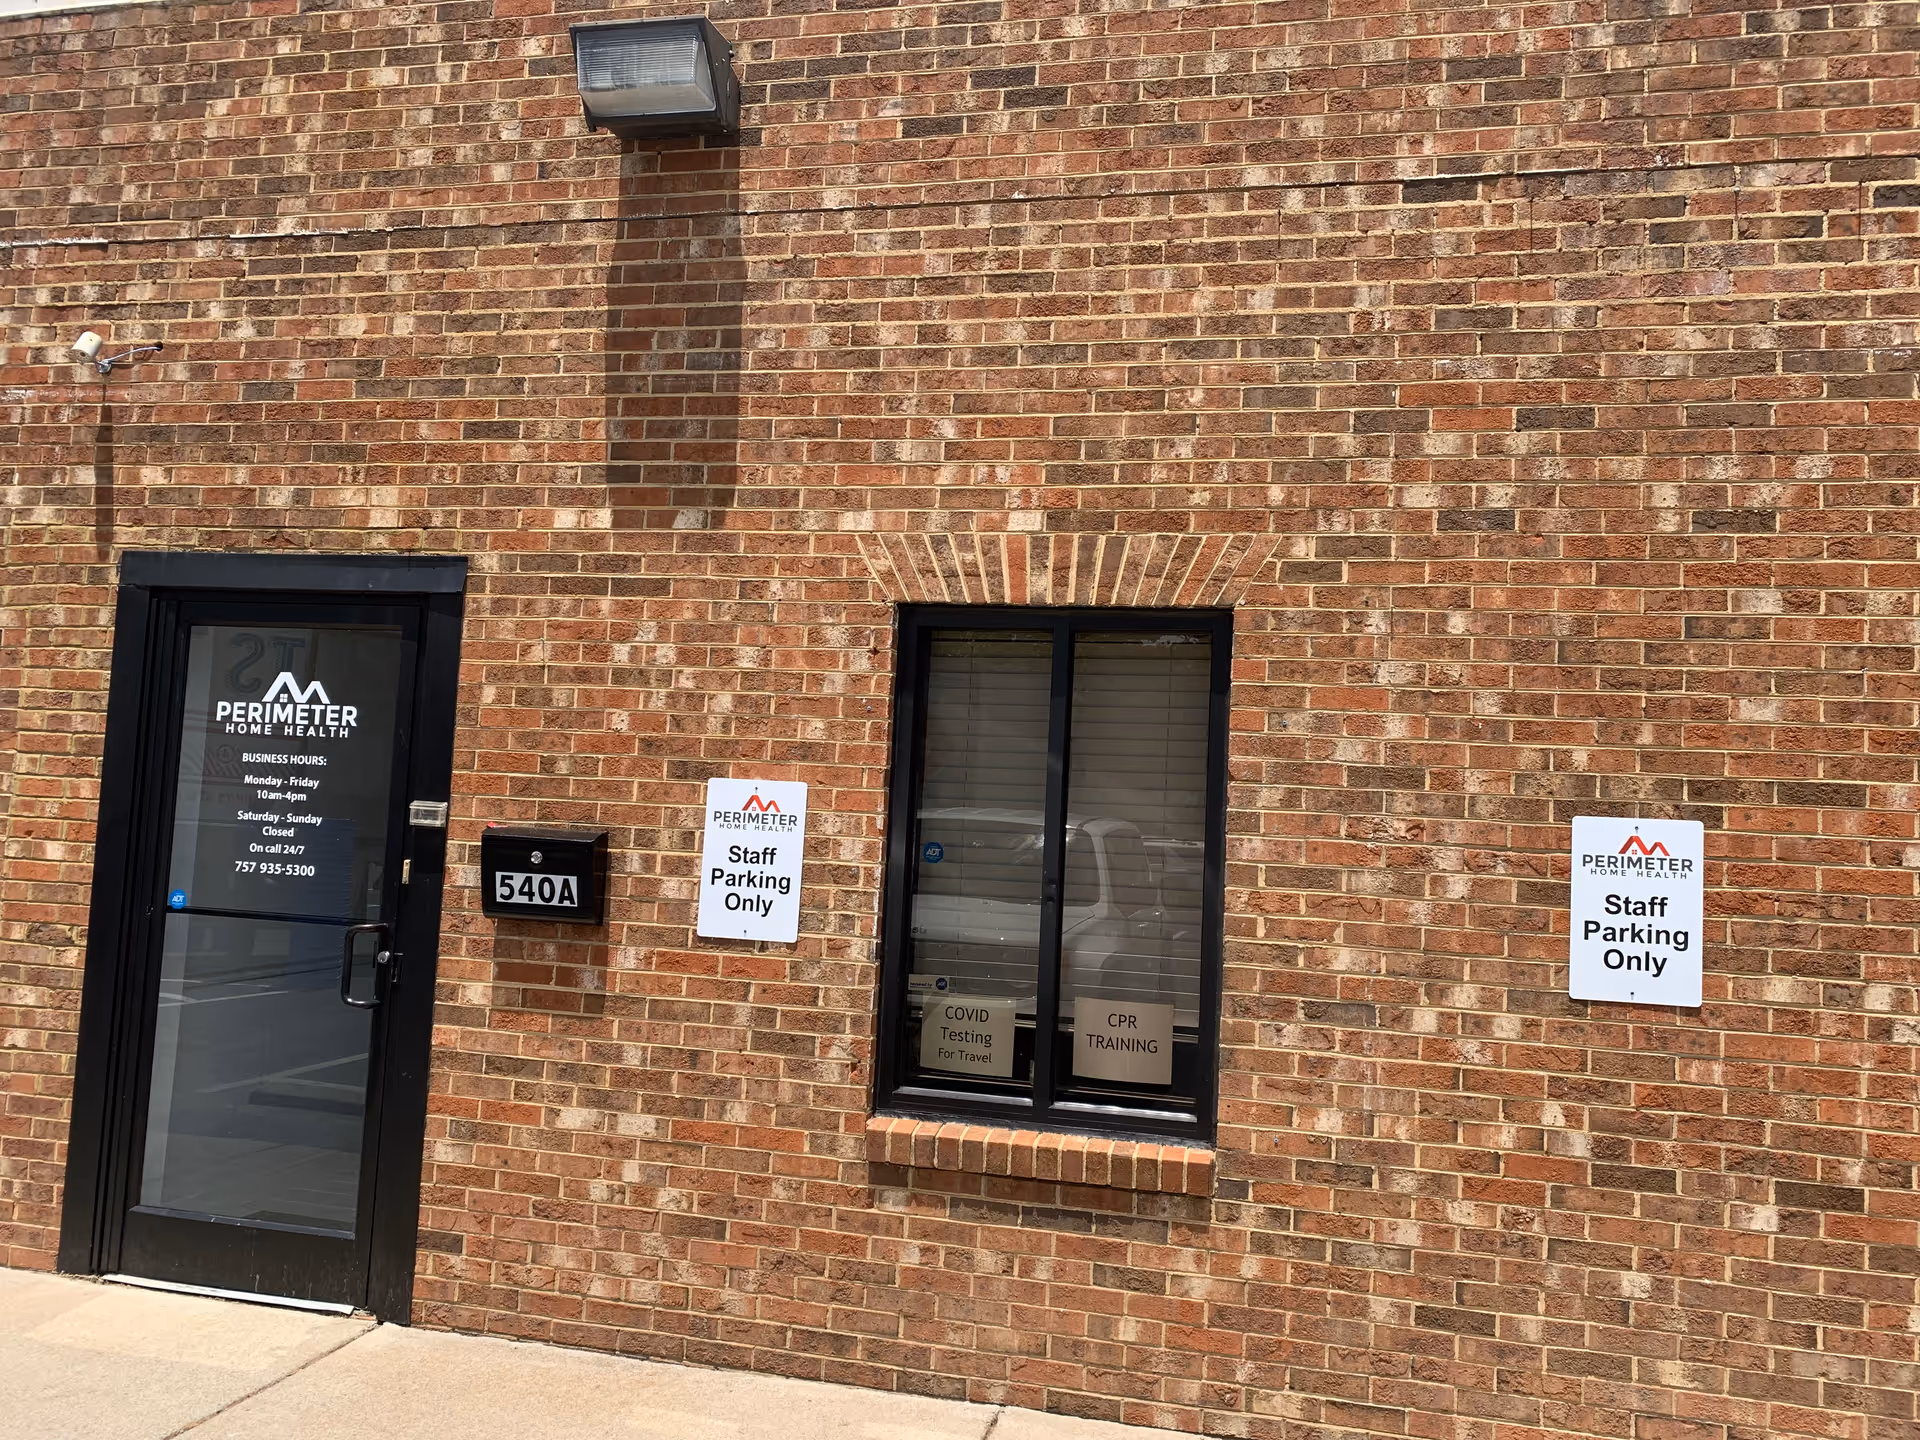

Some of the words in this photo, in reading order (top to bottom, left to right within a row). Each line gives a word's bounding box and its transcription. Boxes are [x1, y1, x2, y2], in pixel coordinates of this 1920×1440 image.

[216, 701, 358, 727] PERIMETER
[225, 723, 273, 737] HOME
[284, 725, 349, 739] HEALTH
[242, 753, 288, 765] BUSINESS
[290, 754, 327, 766] HOURS:
[244, 775, 283, 788] Monday
[289, 776, 320, 789] Friday
[256, 790, 307, 802] 10am-4pm
[237, 811, 280, 824] Saturday
[286, 813, 323, 826] Sunday
[713, 810, 798, 827] PERIMETER
[262, 826, 294, 838] Closed
[719, 822, 748, 831] HOME
[754, 824, 793, 833] HEALTH
[249, 843, 264, 854] On
[265, 843, 281, 854] call
[283, 844, 305, 855] 24/7
[728, 845, 777, 865] Staff
[926, 848, 942, 857] ADT
[235, 861, 256, 873] 757
[260, 862, 315, 877] 935-5300
[1582, 854, 1693, 872] PERIMETER
[711, 868, 791, 895] Parking
[1590, 868, 1627, 877] HOME
[1637, 870, 1687, 880] HEALTH
[499, 874, 576, 906] 540A
[725, 892, 773, 918] Only
[1604, 894, 1669, 917] Staff
[1583, 920, 1689, 952] Parking
[1603, 948, 1668, 978] Only
[945, 1006, 990, 1023] COVID
[1107, 1013, 1138, 1030] CPR
[940, 1026, 992, 1049] Testing
[1086, 1033, 1158, 1054] TRAINING
[938, 1047, 955, 1060] For
[958, 1049, 992, 1064] Travel
